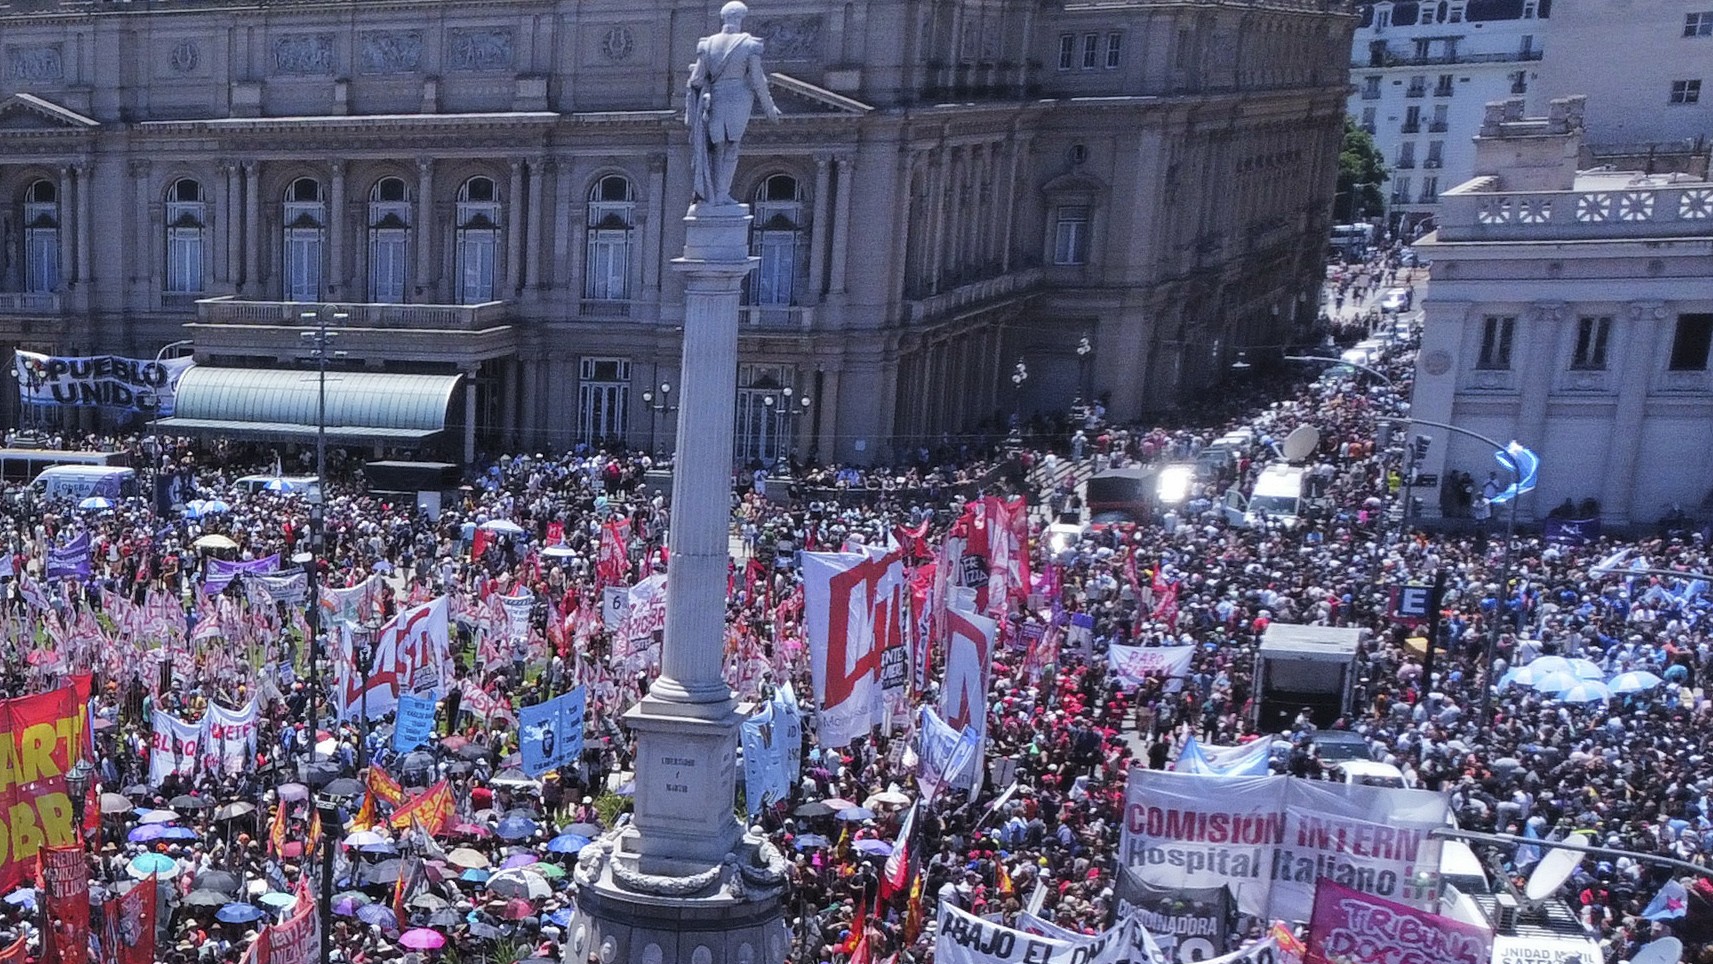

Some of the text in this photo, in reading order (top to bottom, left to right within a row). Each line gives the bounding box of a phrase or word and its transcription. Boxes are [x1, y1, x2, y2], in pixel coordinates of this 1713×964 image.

[48, 357, 168, 388] PUEBLO
[1404, 587, 1427, 614] E
[1127, 802, 1428, 863] COMISIÓN INTERN
[1128, 838, 1397, 898] Hospital Italiano
[941, 911, 1016, 960] ABAJO
